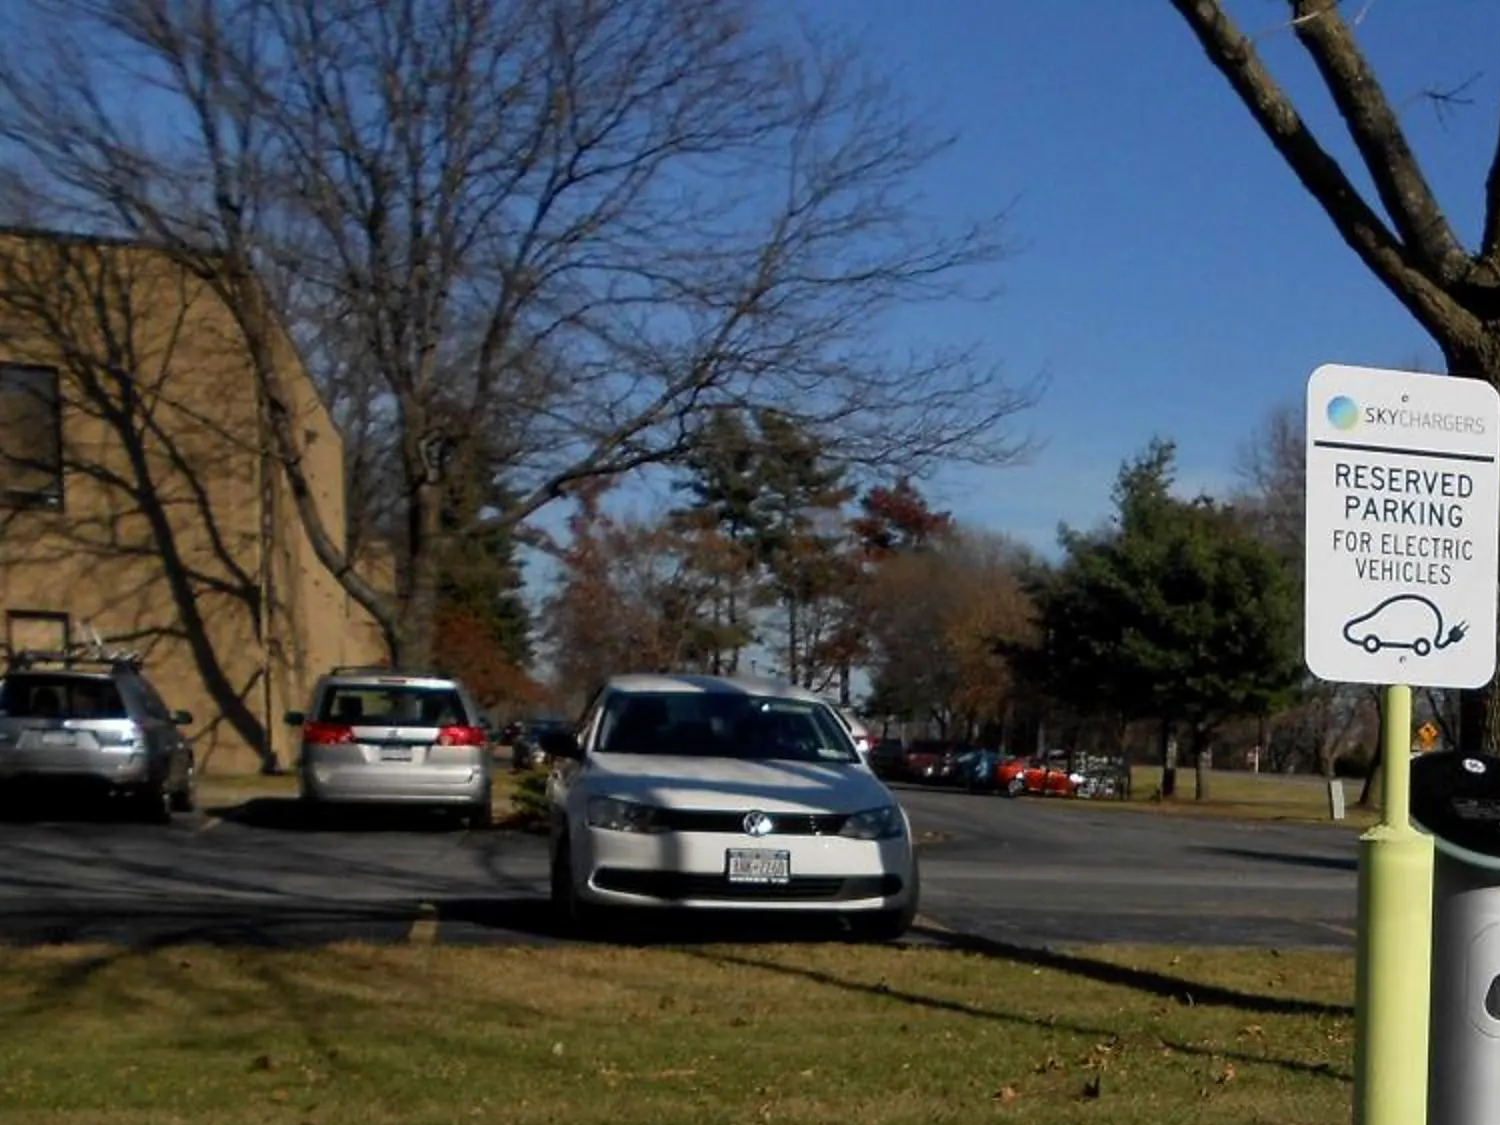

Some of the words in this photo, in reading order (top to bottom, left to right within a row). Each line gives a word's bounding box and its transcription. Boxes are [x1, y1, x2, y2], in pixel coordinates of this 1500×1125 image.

[1365, 407, 1485, 434] SKYCHARGERS
[1335, 463, 1473, 498] RESERVED
[1345, 496, 1463, 528] PARKING
[1333, 530, 1372, 553] FOR
[1381, 534, 1473, 561] ELECTRIC
[1355, 558, 1451, 585] VEHICLES
